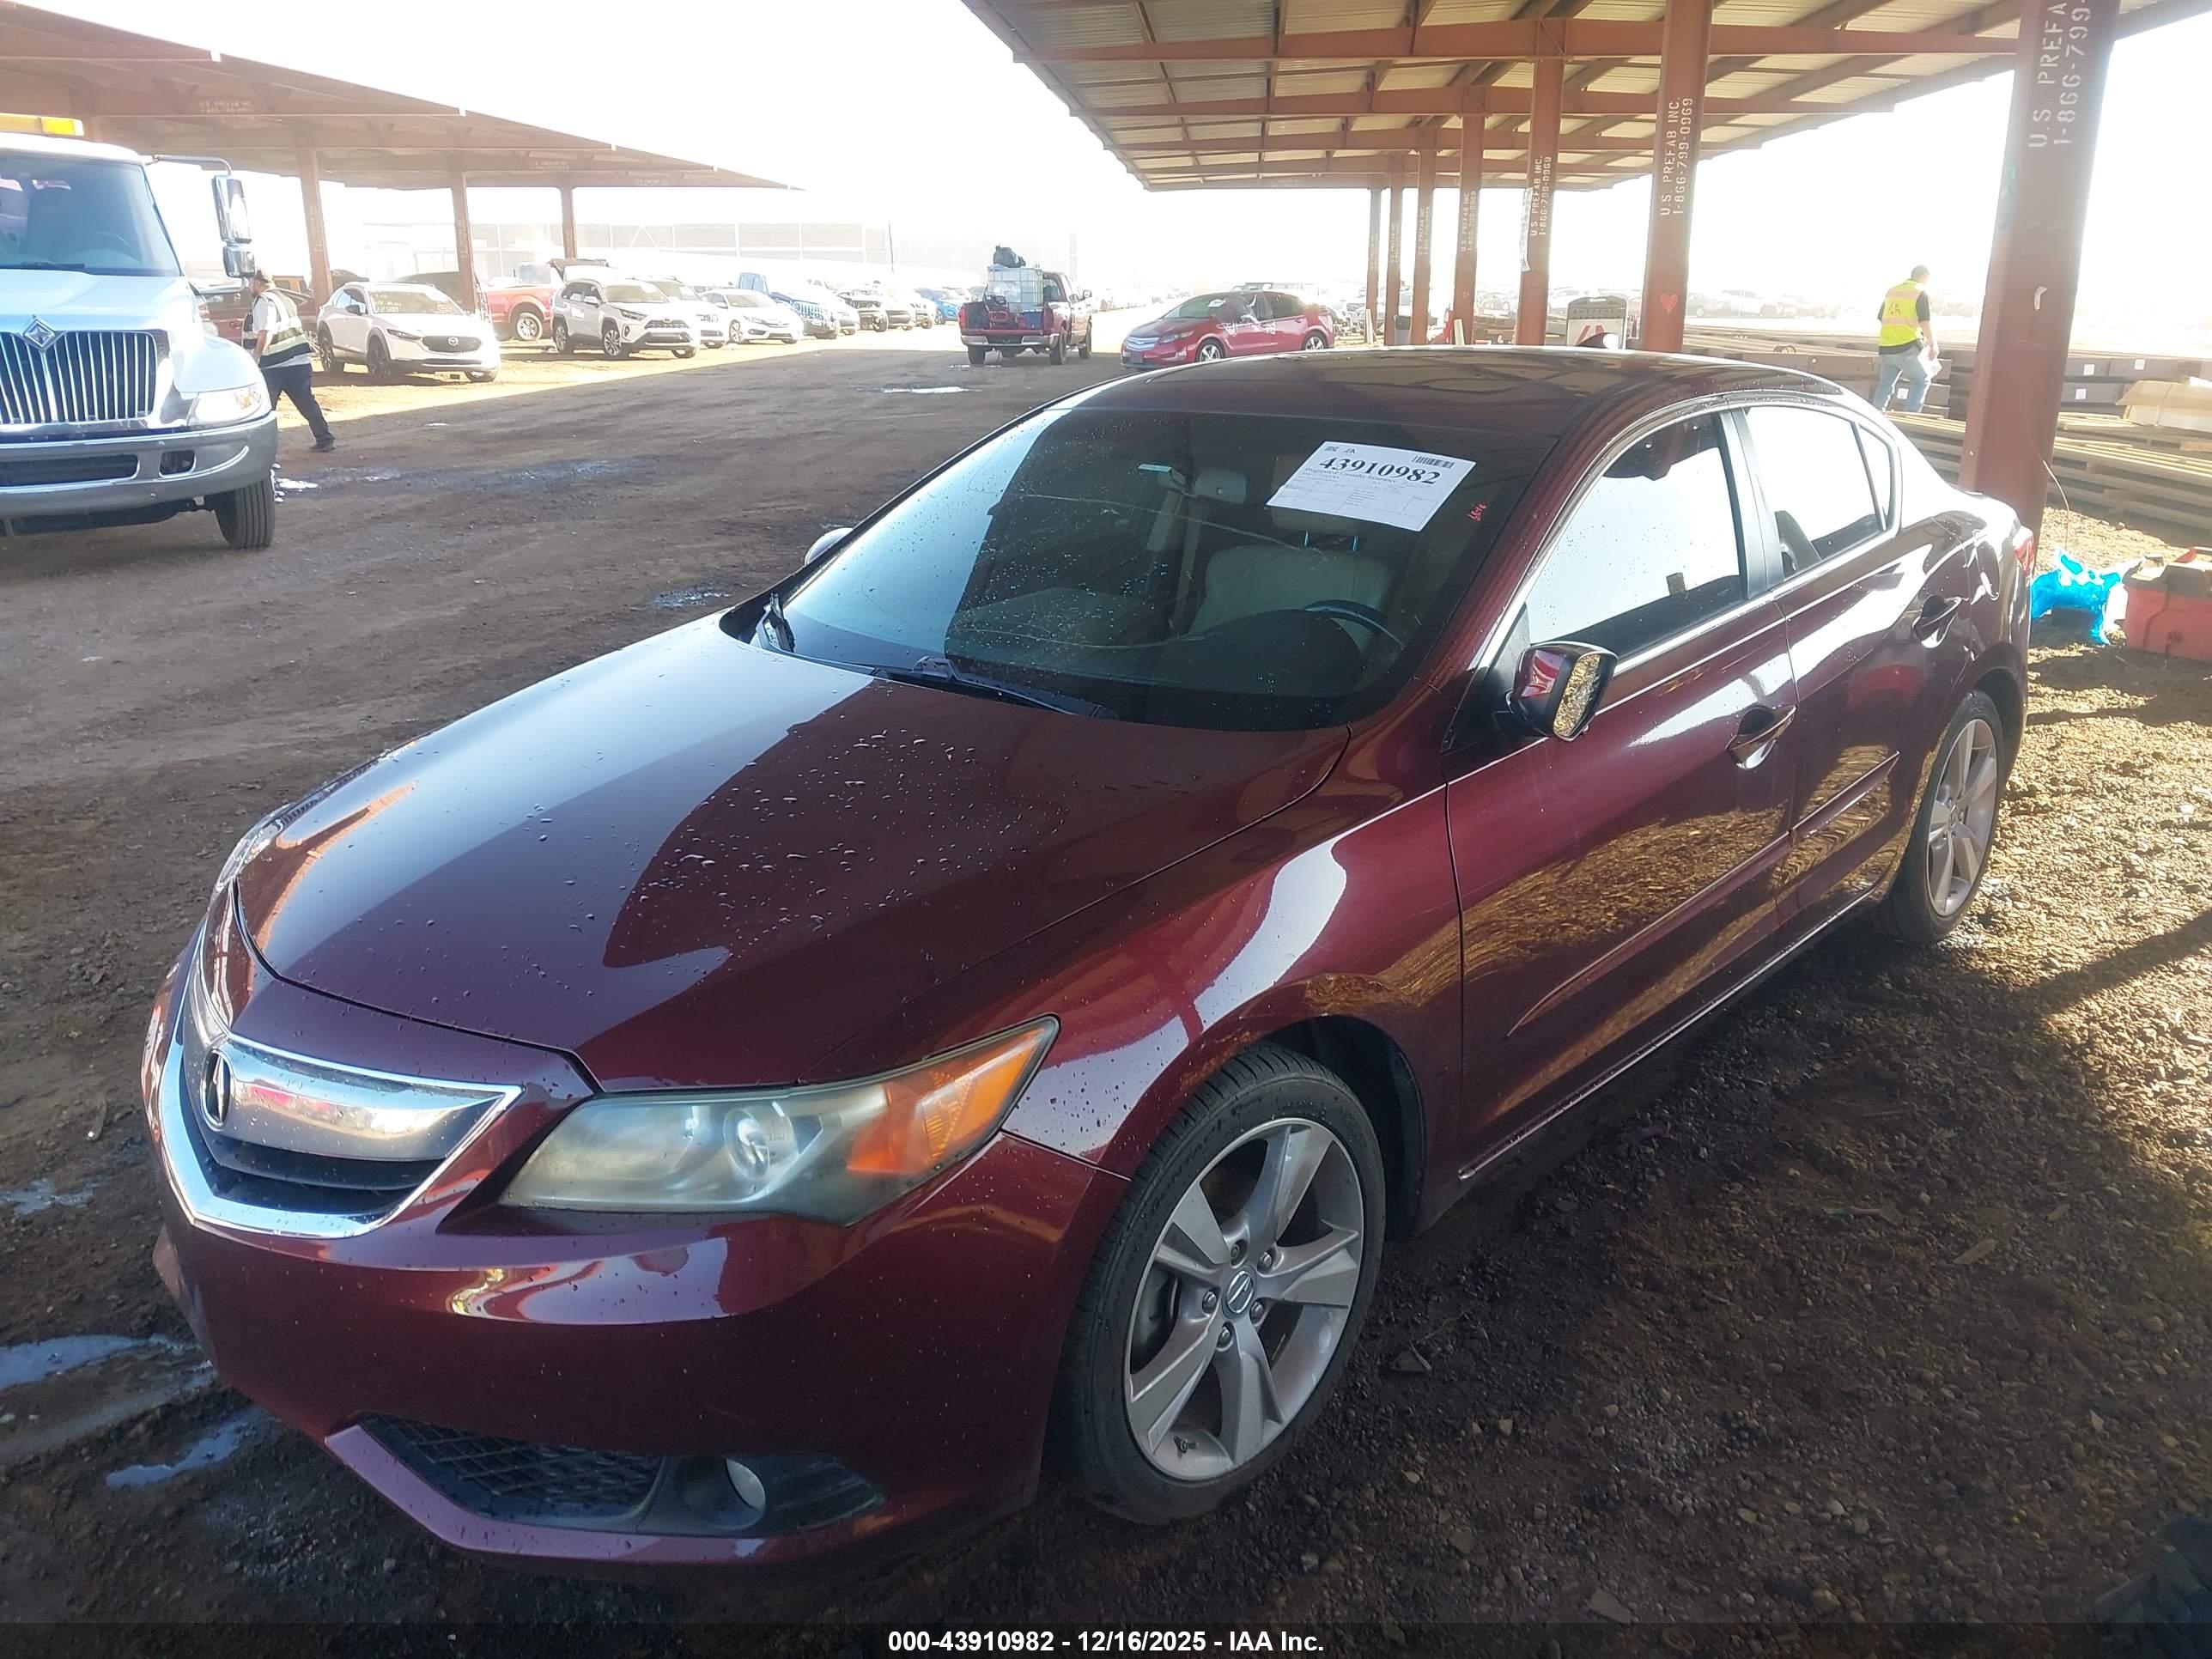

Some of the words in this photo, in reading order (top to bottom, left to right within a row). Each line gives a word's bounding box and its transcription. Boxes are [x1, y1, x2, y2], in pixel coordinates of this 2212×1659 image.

[1668, 97, 1680, 123] INC.
[1662, 130, 1677, 182] PREFAB
[1673, 98, 1693, 215] 1-866-799-0969
[1531, 178, 1541, 214] PREFAB
[1319, 457, 1442, 485] 43910982
